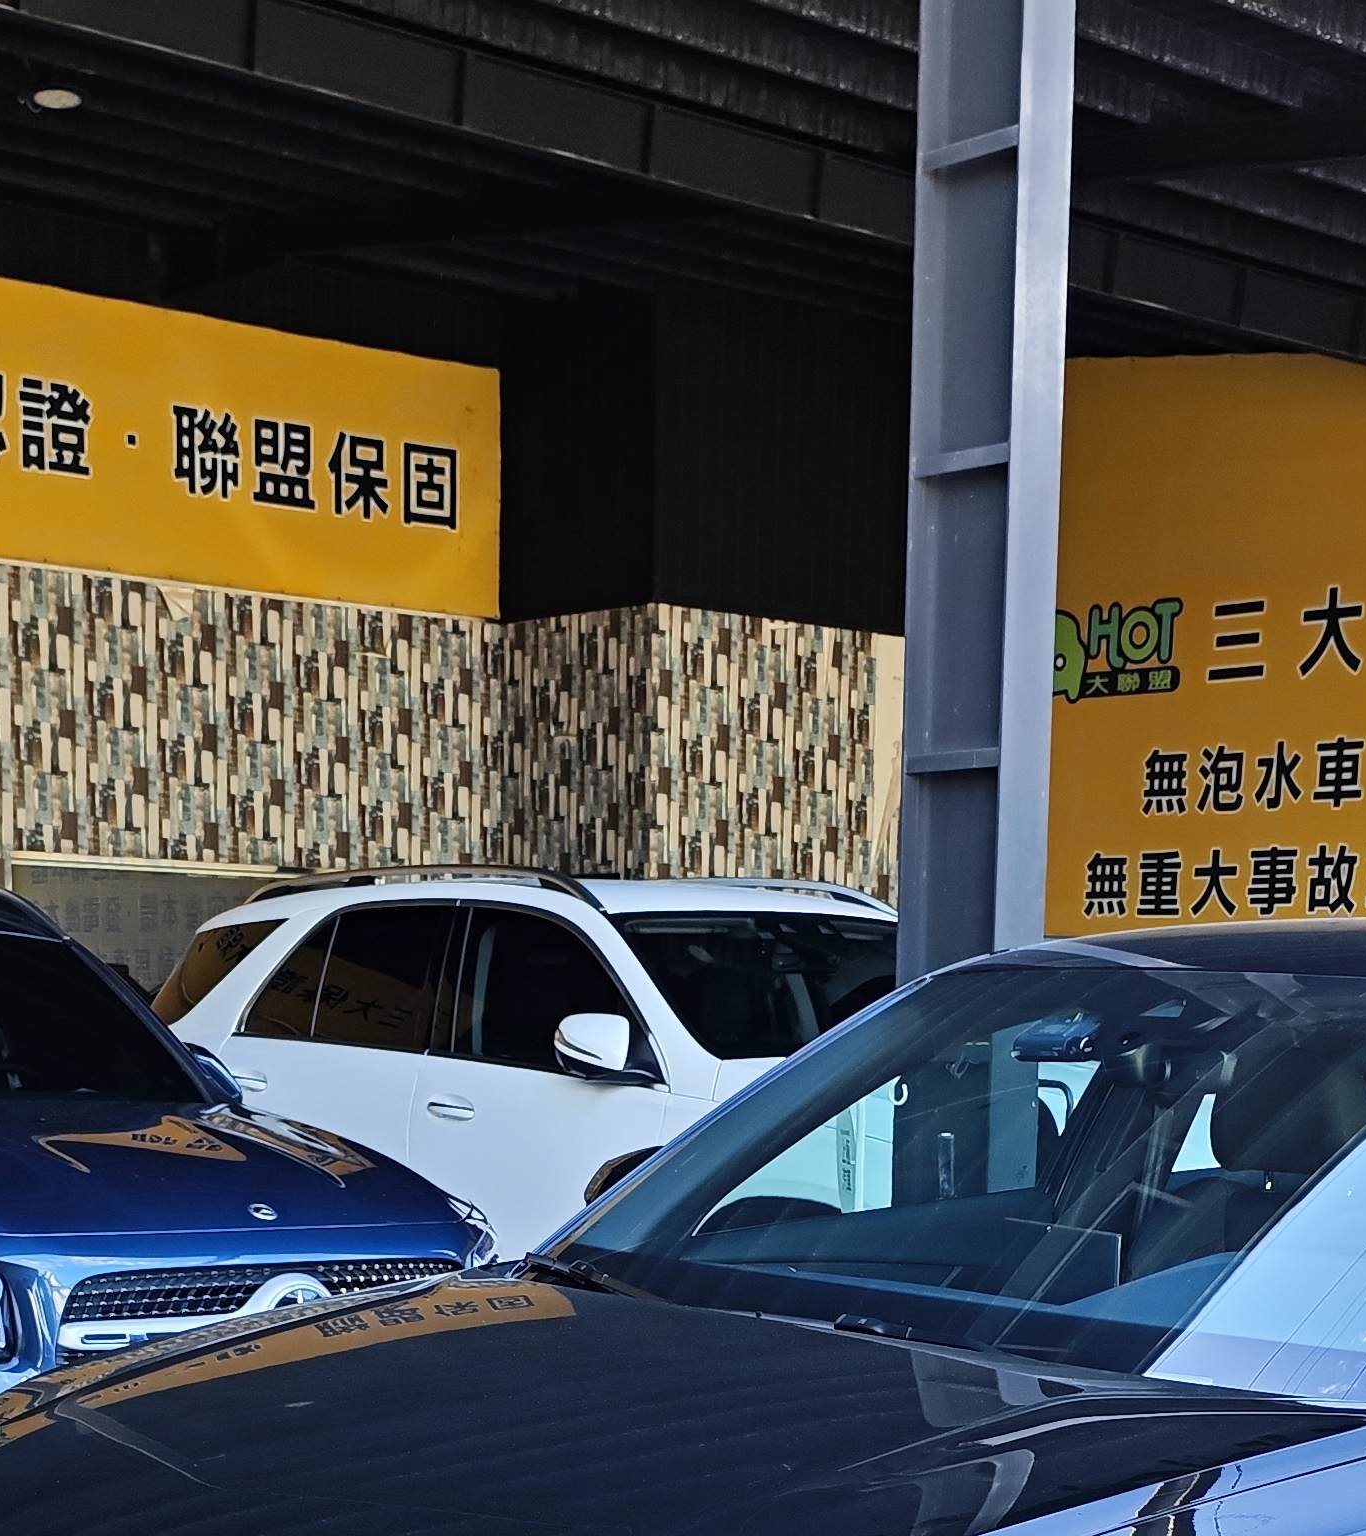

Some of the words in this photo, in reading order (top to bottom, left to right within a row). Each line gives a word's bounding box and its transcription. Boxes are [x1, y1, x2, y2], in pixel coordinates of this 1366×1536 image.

[1088, 597, 1183, 669] HOT
[1085, 669, 1173, 695] 大聯盟
[1141, 736, 1366, 816] 無泡水車
